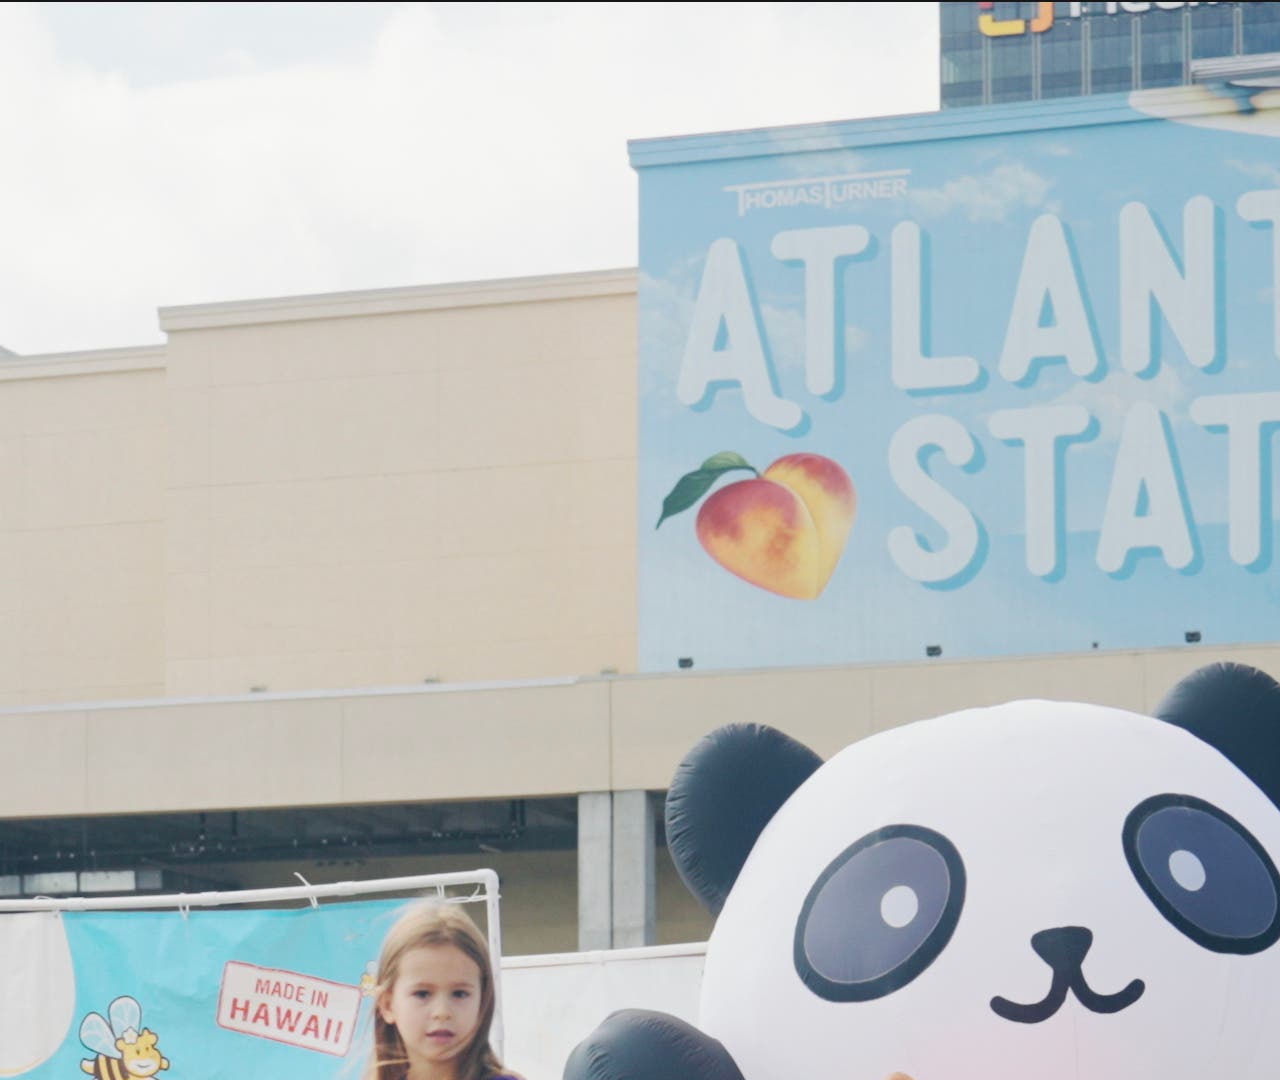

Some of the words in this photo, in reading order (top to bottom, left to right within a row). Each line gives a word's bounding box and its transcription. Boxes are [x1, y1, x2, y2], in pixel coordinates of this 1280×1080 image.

[255, 978, 306, 1003] MADE
[310, 989, 328, 1009] IN
[229, 997, 344, 1044] HAWAII
